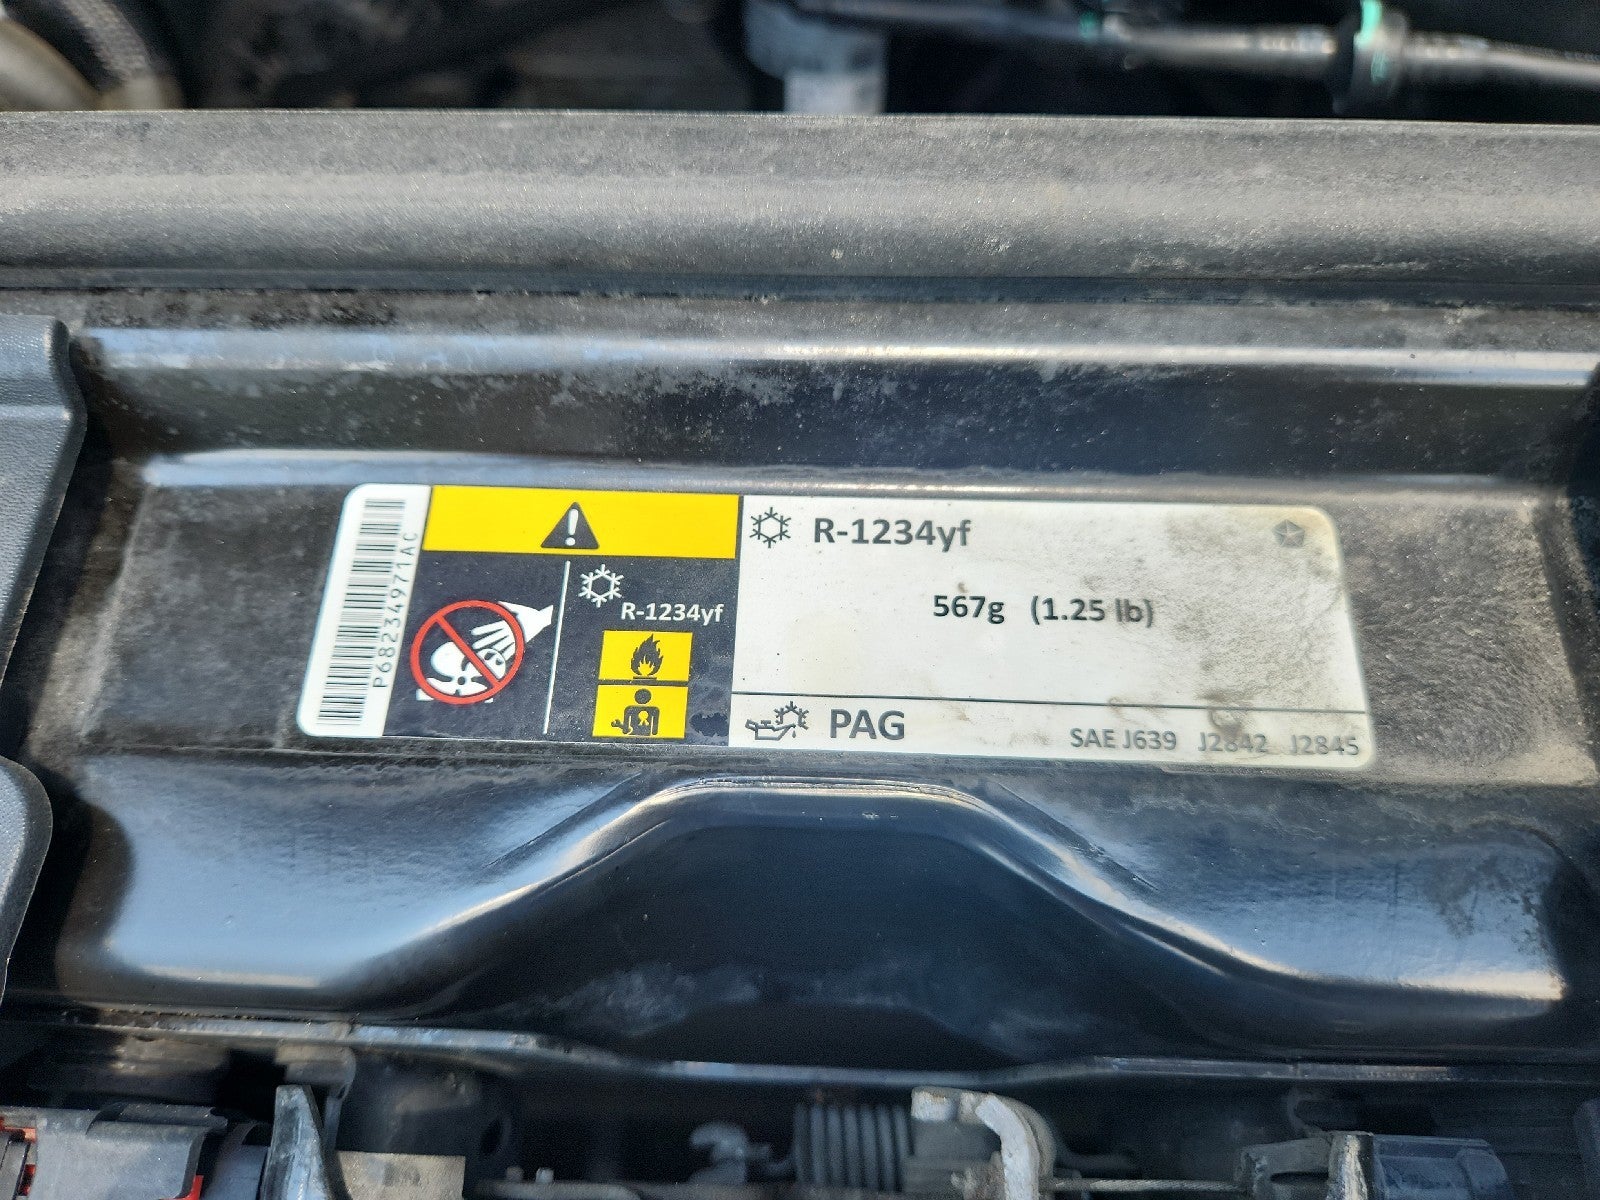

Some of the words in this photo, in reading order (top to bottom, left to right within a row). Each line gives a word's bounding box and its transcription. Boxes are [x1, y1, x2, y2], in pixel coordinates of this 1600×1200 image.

[814, 517, 971, 552] R-1234yf
[373, 532, 418, 688] P68234971AC
[621, 602, 724, 626] R-1234yf
[933, 595, 1005, 624] 567g
[1031, 596, 1105, 625] (1.25
[1116, 598, 1154, 627] lb)
[830, 709, 905, 740] PAG
[1070, 728, 1115, 748] SAE
[1122, 729, 1177, 750] J639
[1199, 731, 1267, 753] J2842
[1290, 734, 1360, 756] J2845
